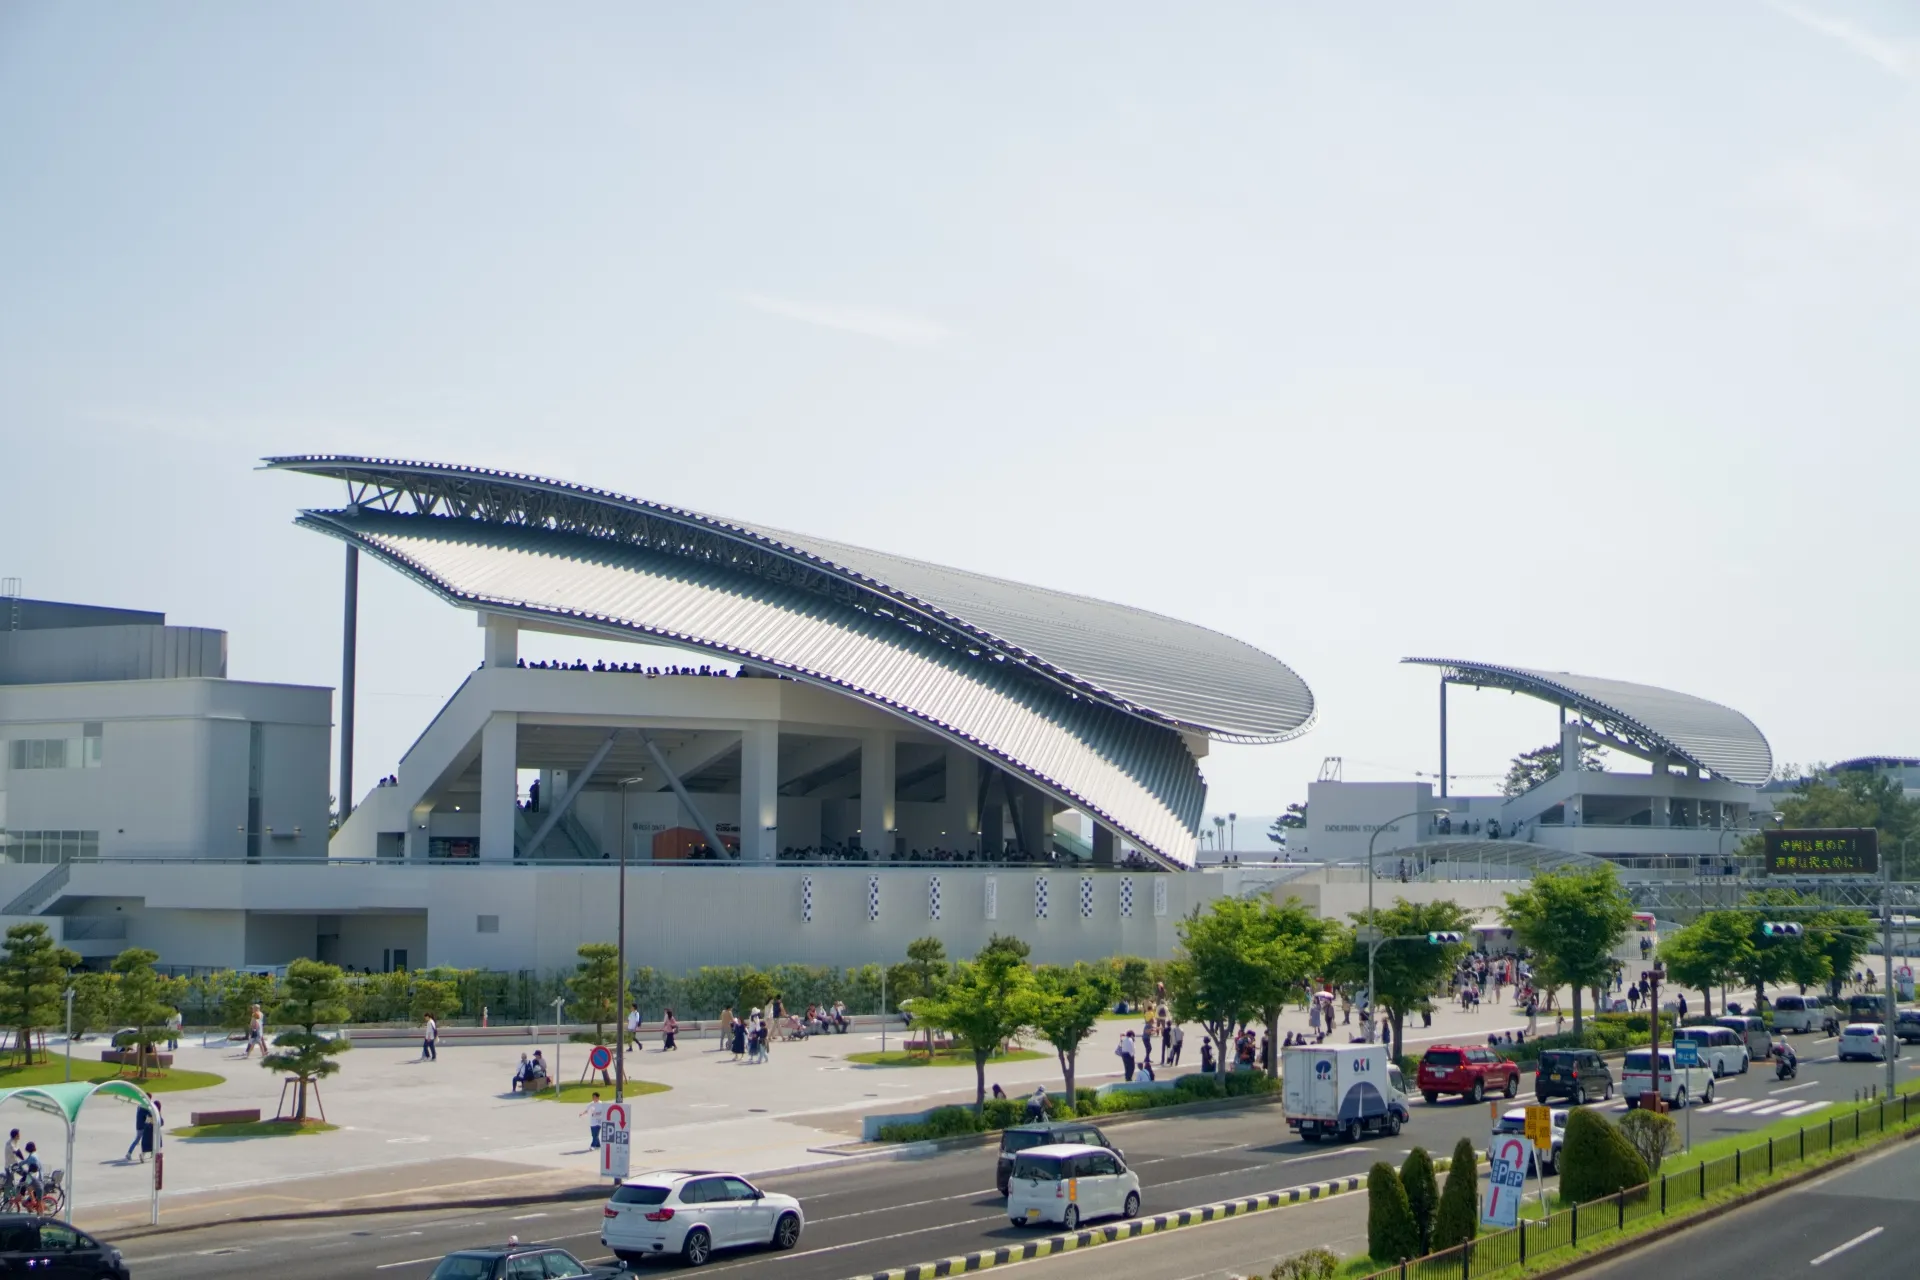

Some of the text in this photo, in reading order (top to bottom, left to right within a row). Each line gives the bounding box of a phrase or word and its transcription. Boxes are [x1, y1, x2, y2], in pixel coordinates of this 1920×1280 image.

[1324, 824, 1360, 832] DOLPHIN
[1353, 1058, 1370, 1072] OKI
[607, 1125, 614, 1140] P
[621, 1132, 628, 1143] P
[1498, 1163, 1508, 1183] P
[1514, 1173, 1522, 1185] P
